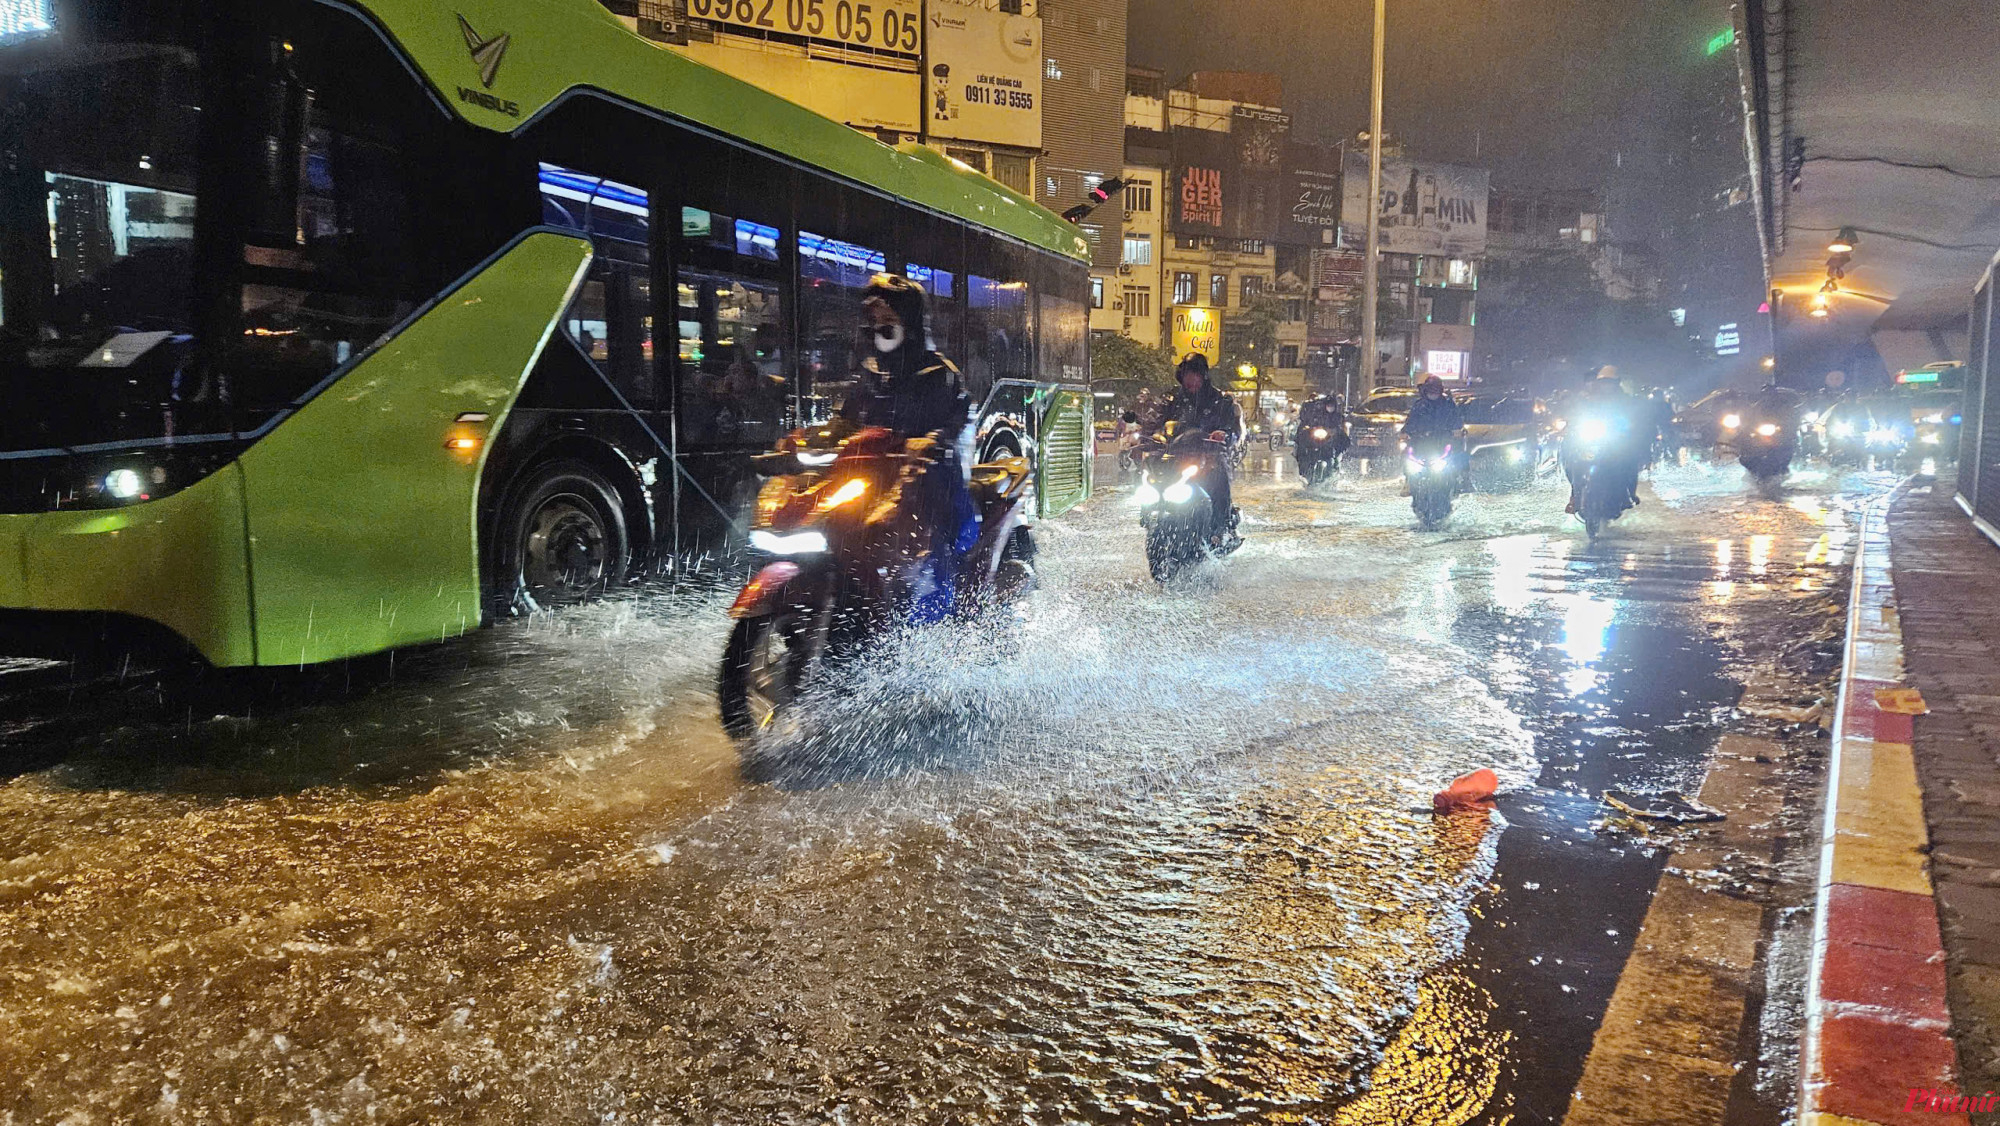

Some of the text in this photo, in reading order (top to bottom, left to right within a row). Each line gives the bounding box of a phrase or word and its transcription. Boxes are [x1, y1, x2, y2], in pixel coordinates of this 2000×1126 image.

[787, 0, 823, 35] 05
[836, 1, 872, 43] 05
[883, 9, 918, 51] 05
[977, 73, 1022, 88] LIÊN HỆ QUẢNG CÁO
[457, 86, 519, 118] VINBUS
[966, 85, 1033, 110] 0911 39 5555
[1182, 166, 1220, 188] JUN
[1182, 184, 1222, 207] GER
[1192, 336, 1215, 353] Café
